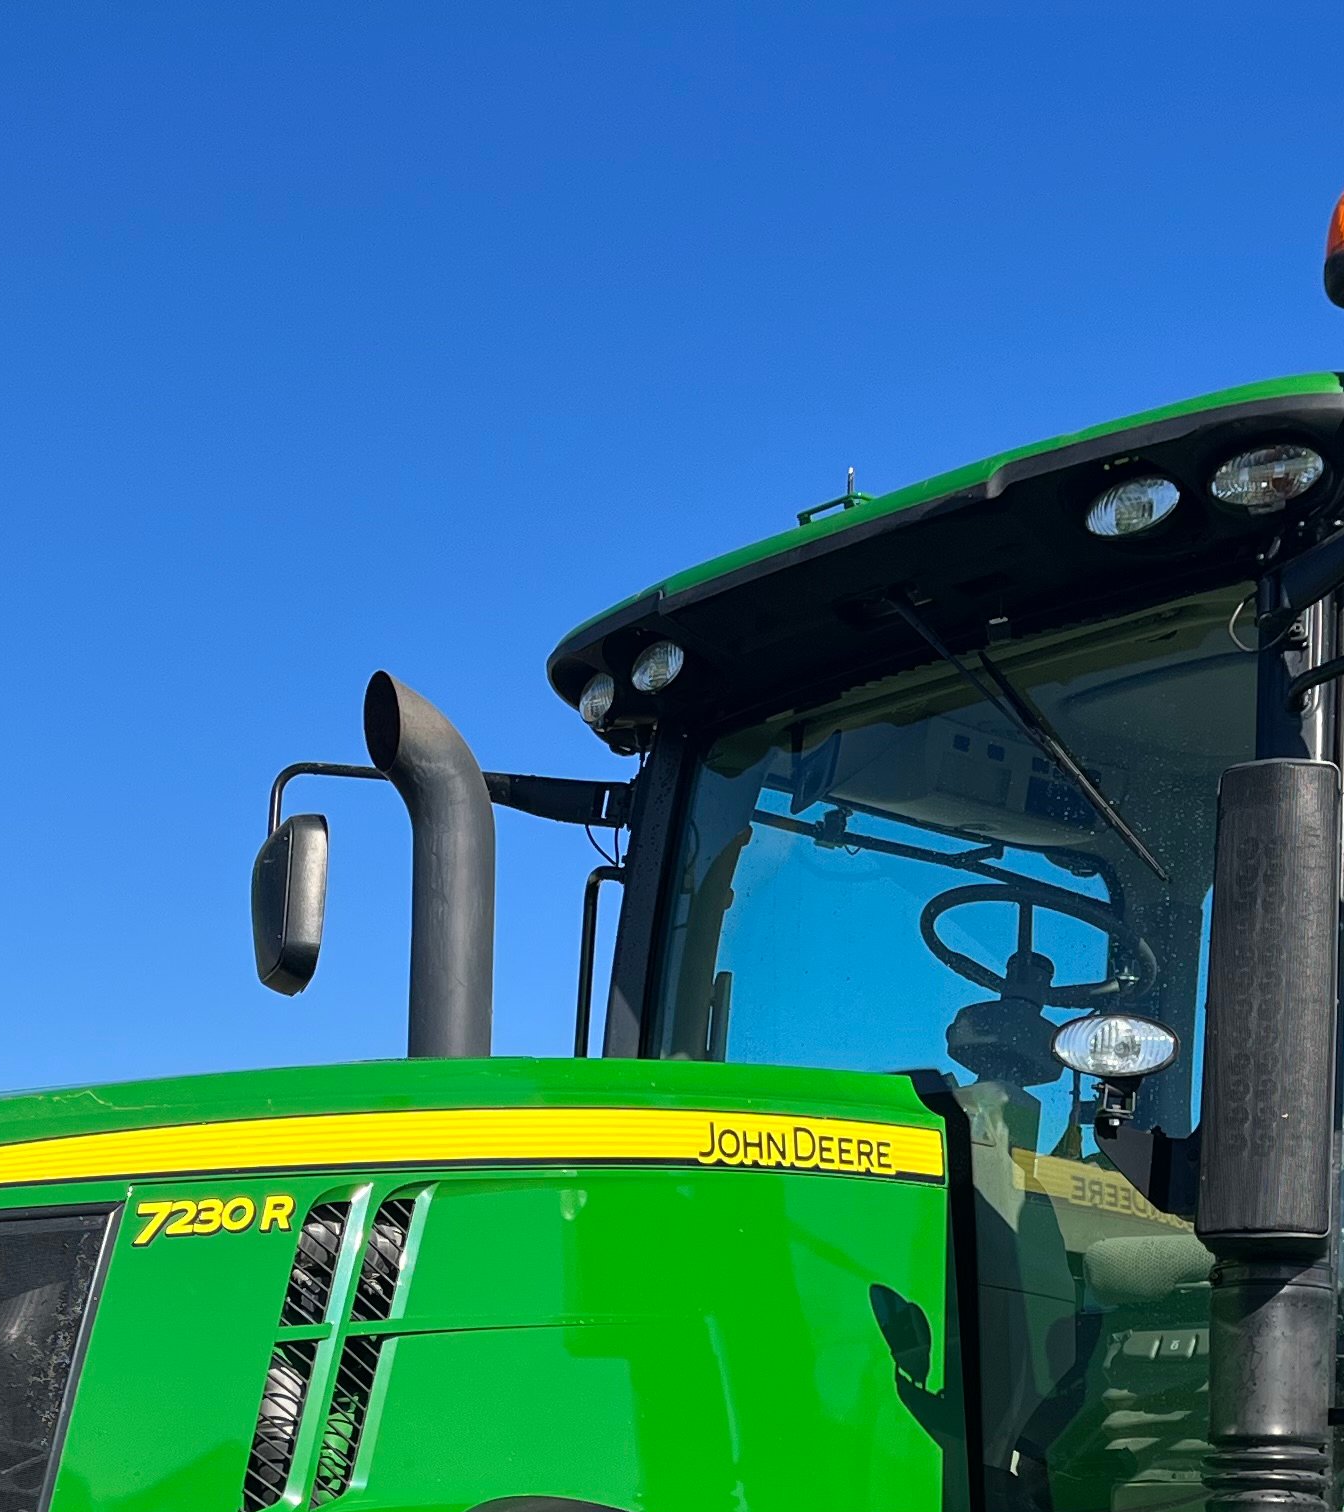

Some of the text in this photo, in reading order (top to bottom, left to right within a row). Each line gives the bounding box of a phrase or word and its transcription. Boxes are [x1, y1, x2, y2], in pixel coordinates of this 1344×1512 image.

[698, 1121, 893, 1169] JOHN DEERE
[132, 1194, 296, 1248] 7230 R
